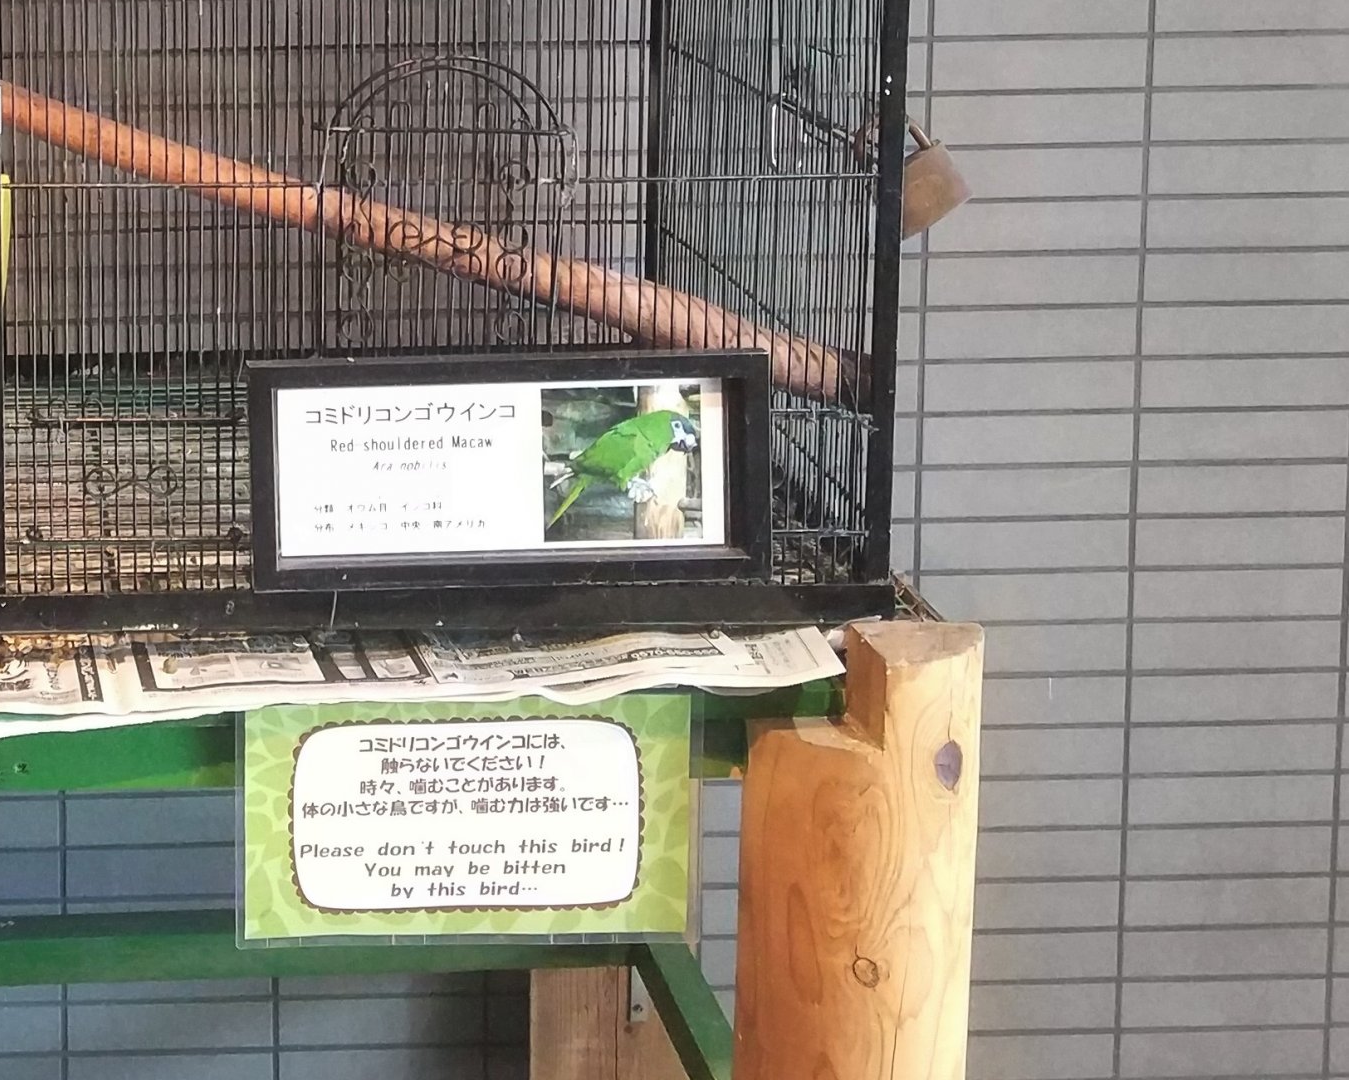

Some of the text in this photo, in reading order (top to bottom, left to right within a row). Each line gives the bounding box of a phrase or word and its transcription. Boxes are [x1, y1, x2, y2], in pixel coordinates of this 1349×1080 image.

[305, 402, 516, 425] コミドリコンゴウインコ
[330, 435, 493, 452] Red shouldered Macaw
[372, 461, 394, 472] Ara
[349, 520, 388, 531] メキコ
[359, 734, 567, 753] コミドリコンゴウインコには、
[380, 756, 546, 775] 触らないでください！
[359, 777, 567, 796] 時々、噛むことがあります。
[299, 844, 365, 858] Please
[377, 840, 435, 856] don't
[448, 839, 506, 855] touch
[518, 838, 558, 854] this
[364, 860, 567, 877] You may be bitten
[390, 883, 414, 898] by
[427, 881, 467, 896] this
